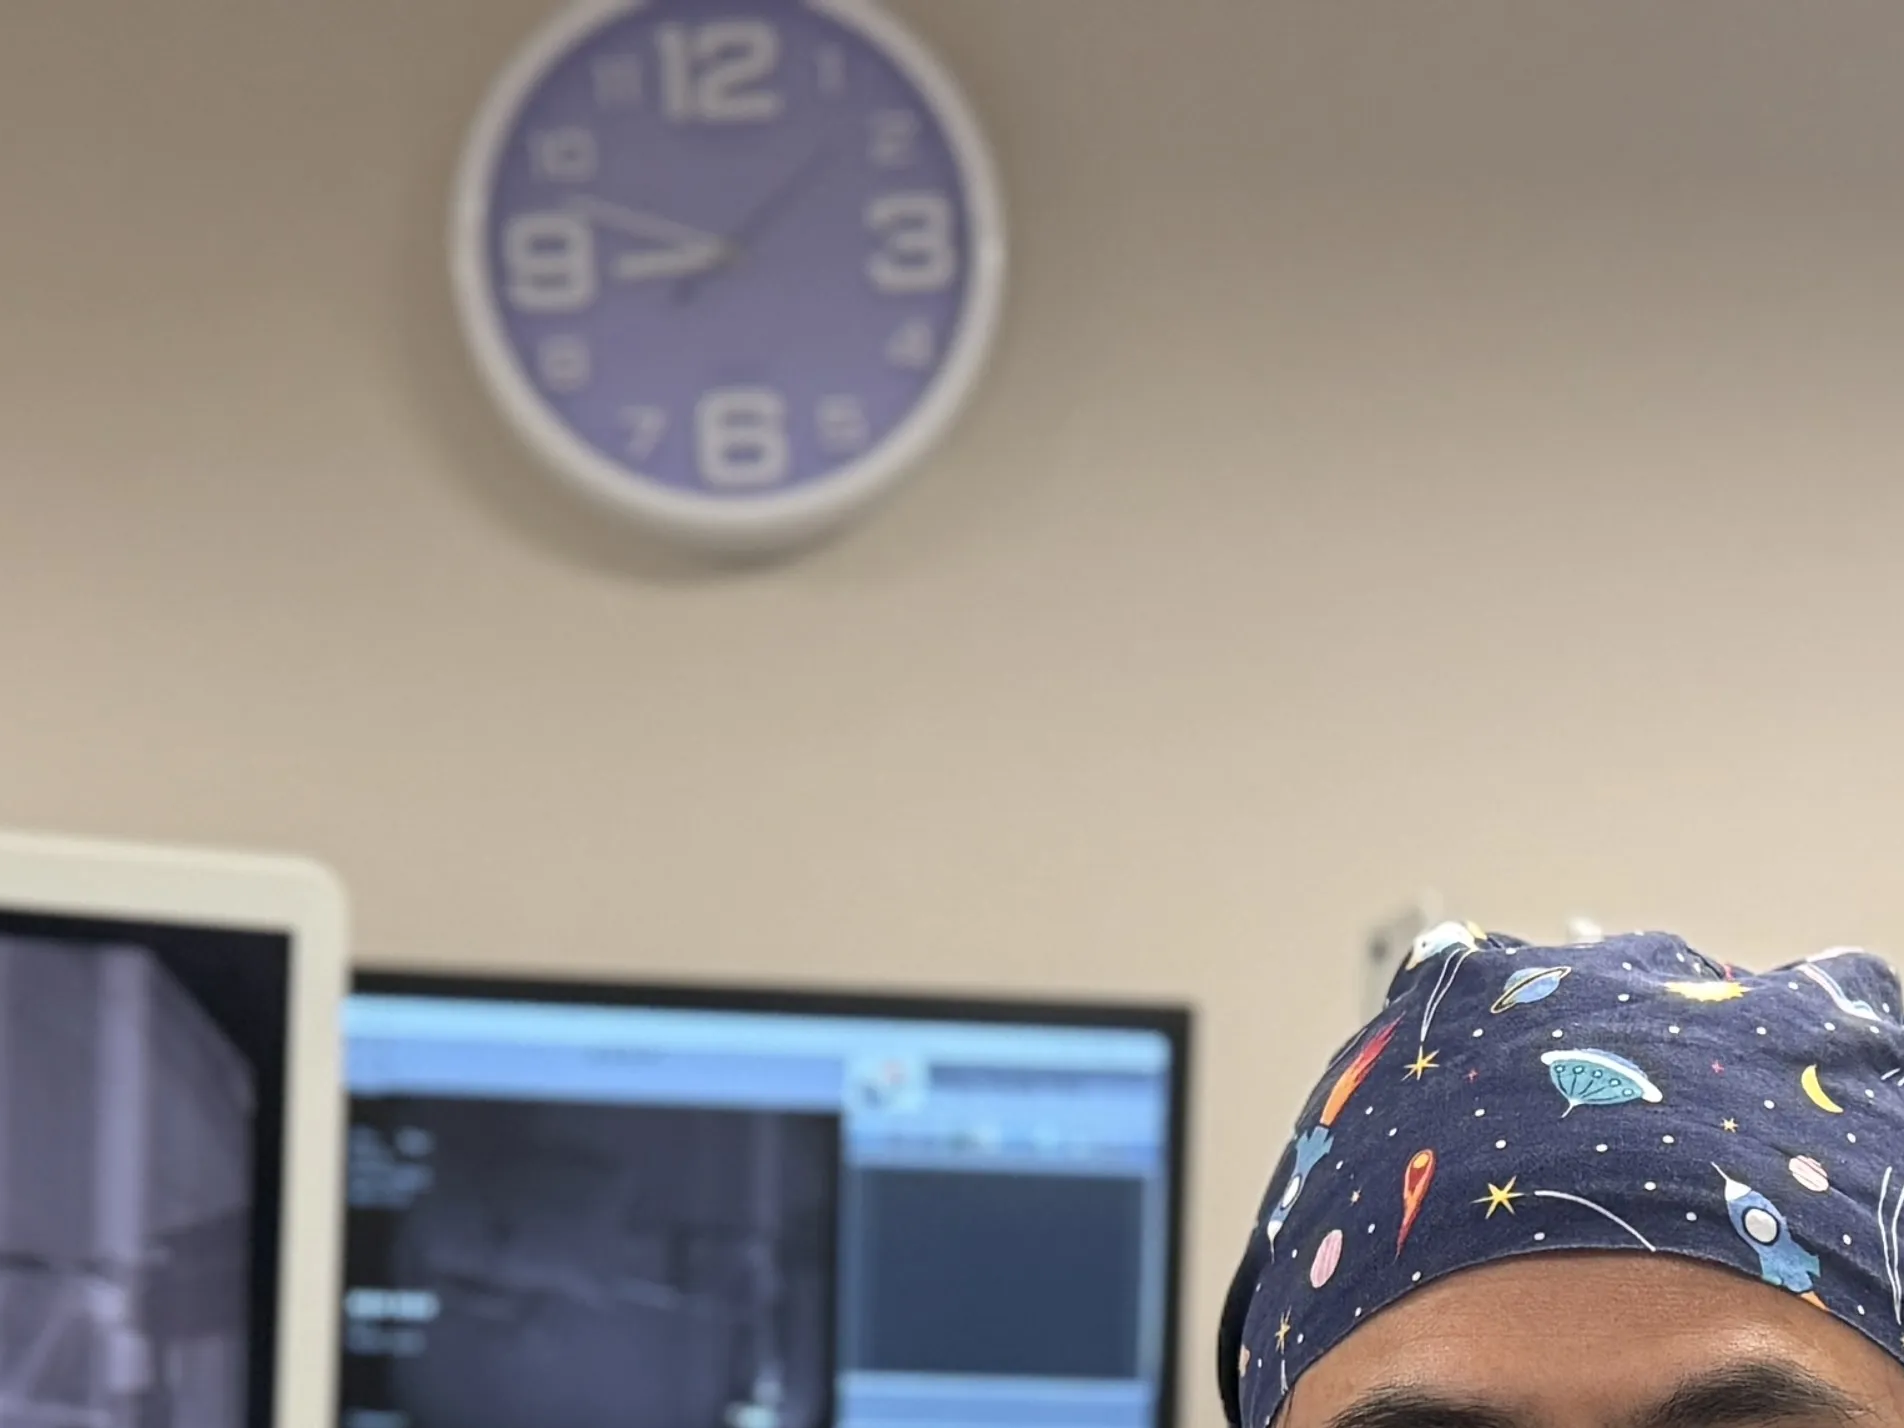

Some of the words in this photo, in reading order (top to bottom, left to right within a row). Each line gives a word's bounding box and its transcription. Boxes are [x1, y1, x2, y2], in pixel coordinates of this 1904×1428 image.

[656, 18, 785, 122] 12
[502, 212, 598, 313] 9
[863, 191, 957, 294] 3
[694, 386, 793, 487] 6
